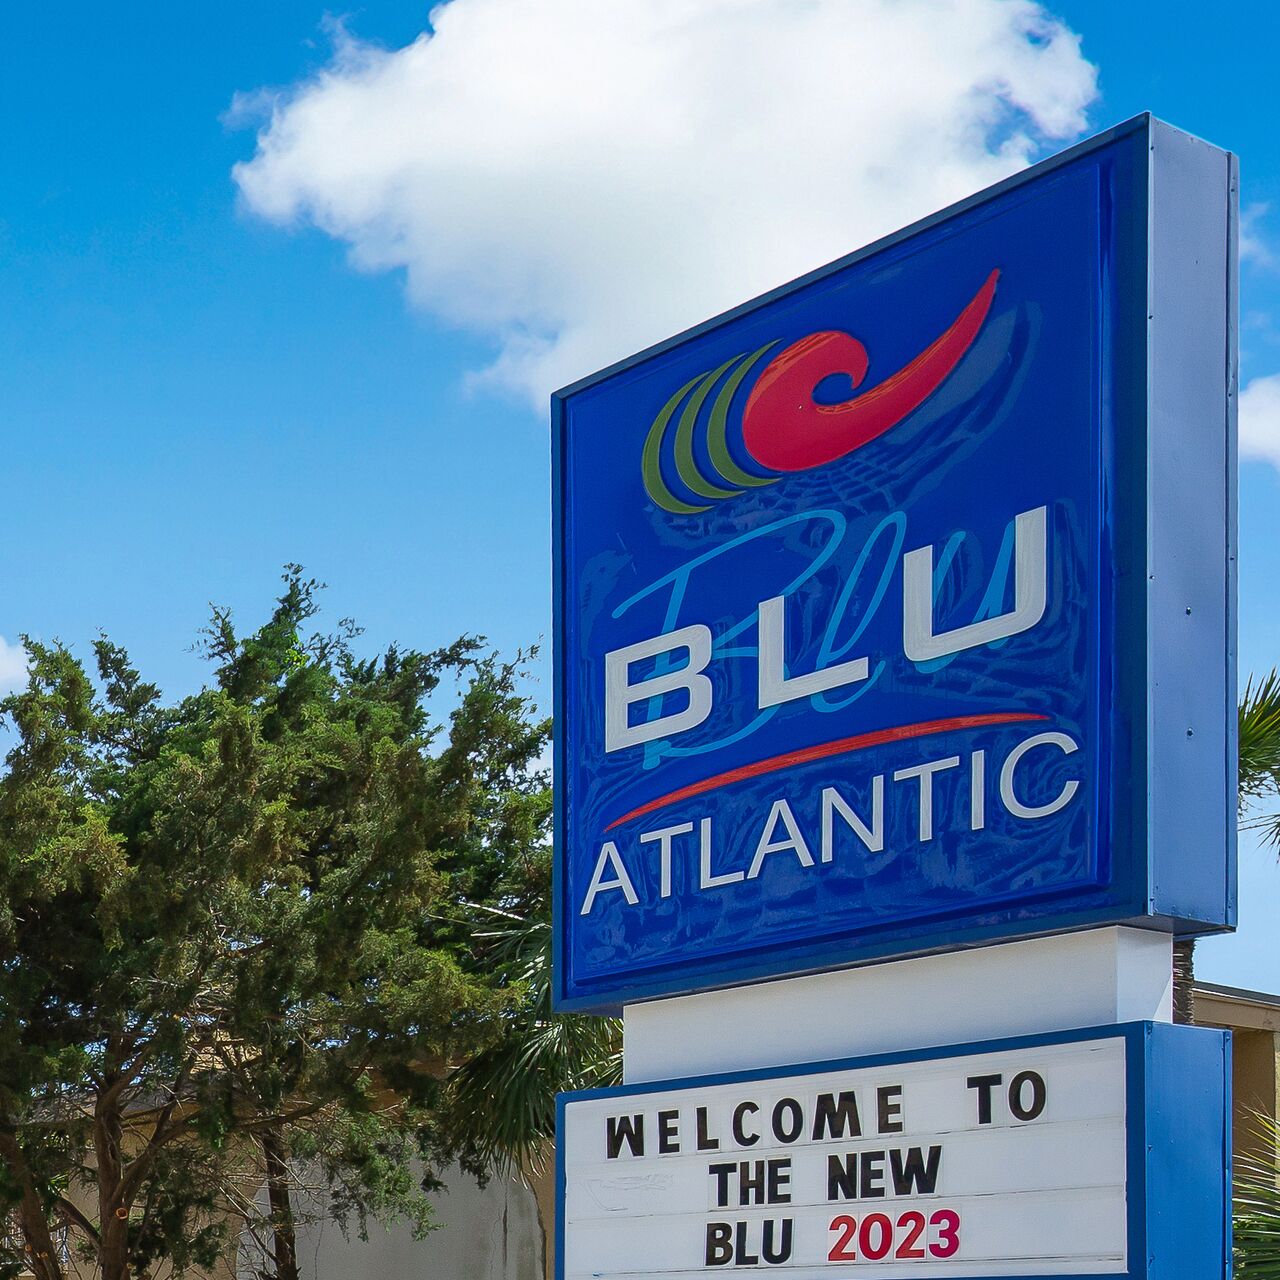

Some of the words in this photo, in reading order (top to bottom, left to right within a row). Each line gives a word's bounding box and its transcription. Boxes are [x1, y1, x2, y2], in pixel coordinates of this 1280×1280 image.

[605, 505, 1047, 753] BLU
[580, 731, 1080, 916] ATLANTIC
[606, 1084, 904, 1159] WELCOME
[967, 1069, 1047, 1124] TO
[708, 1157, 792, 1207] THE
[827, 1145, 943, 1200] NEW
[705, 1218, 794, 1266] BLU
[828, 1209, 961, 1262] 2023
